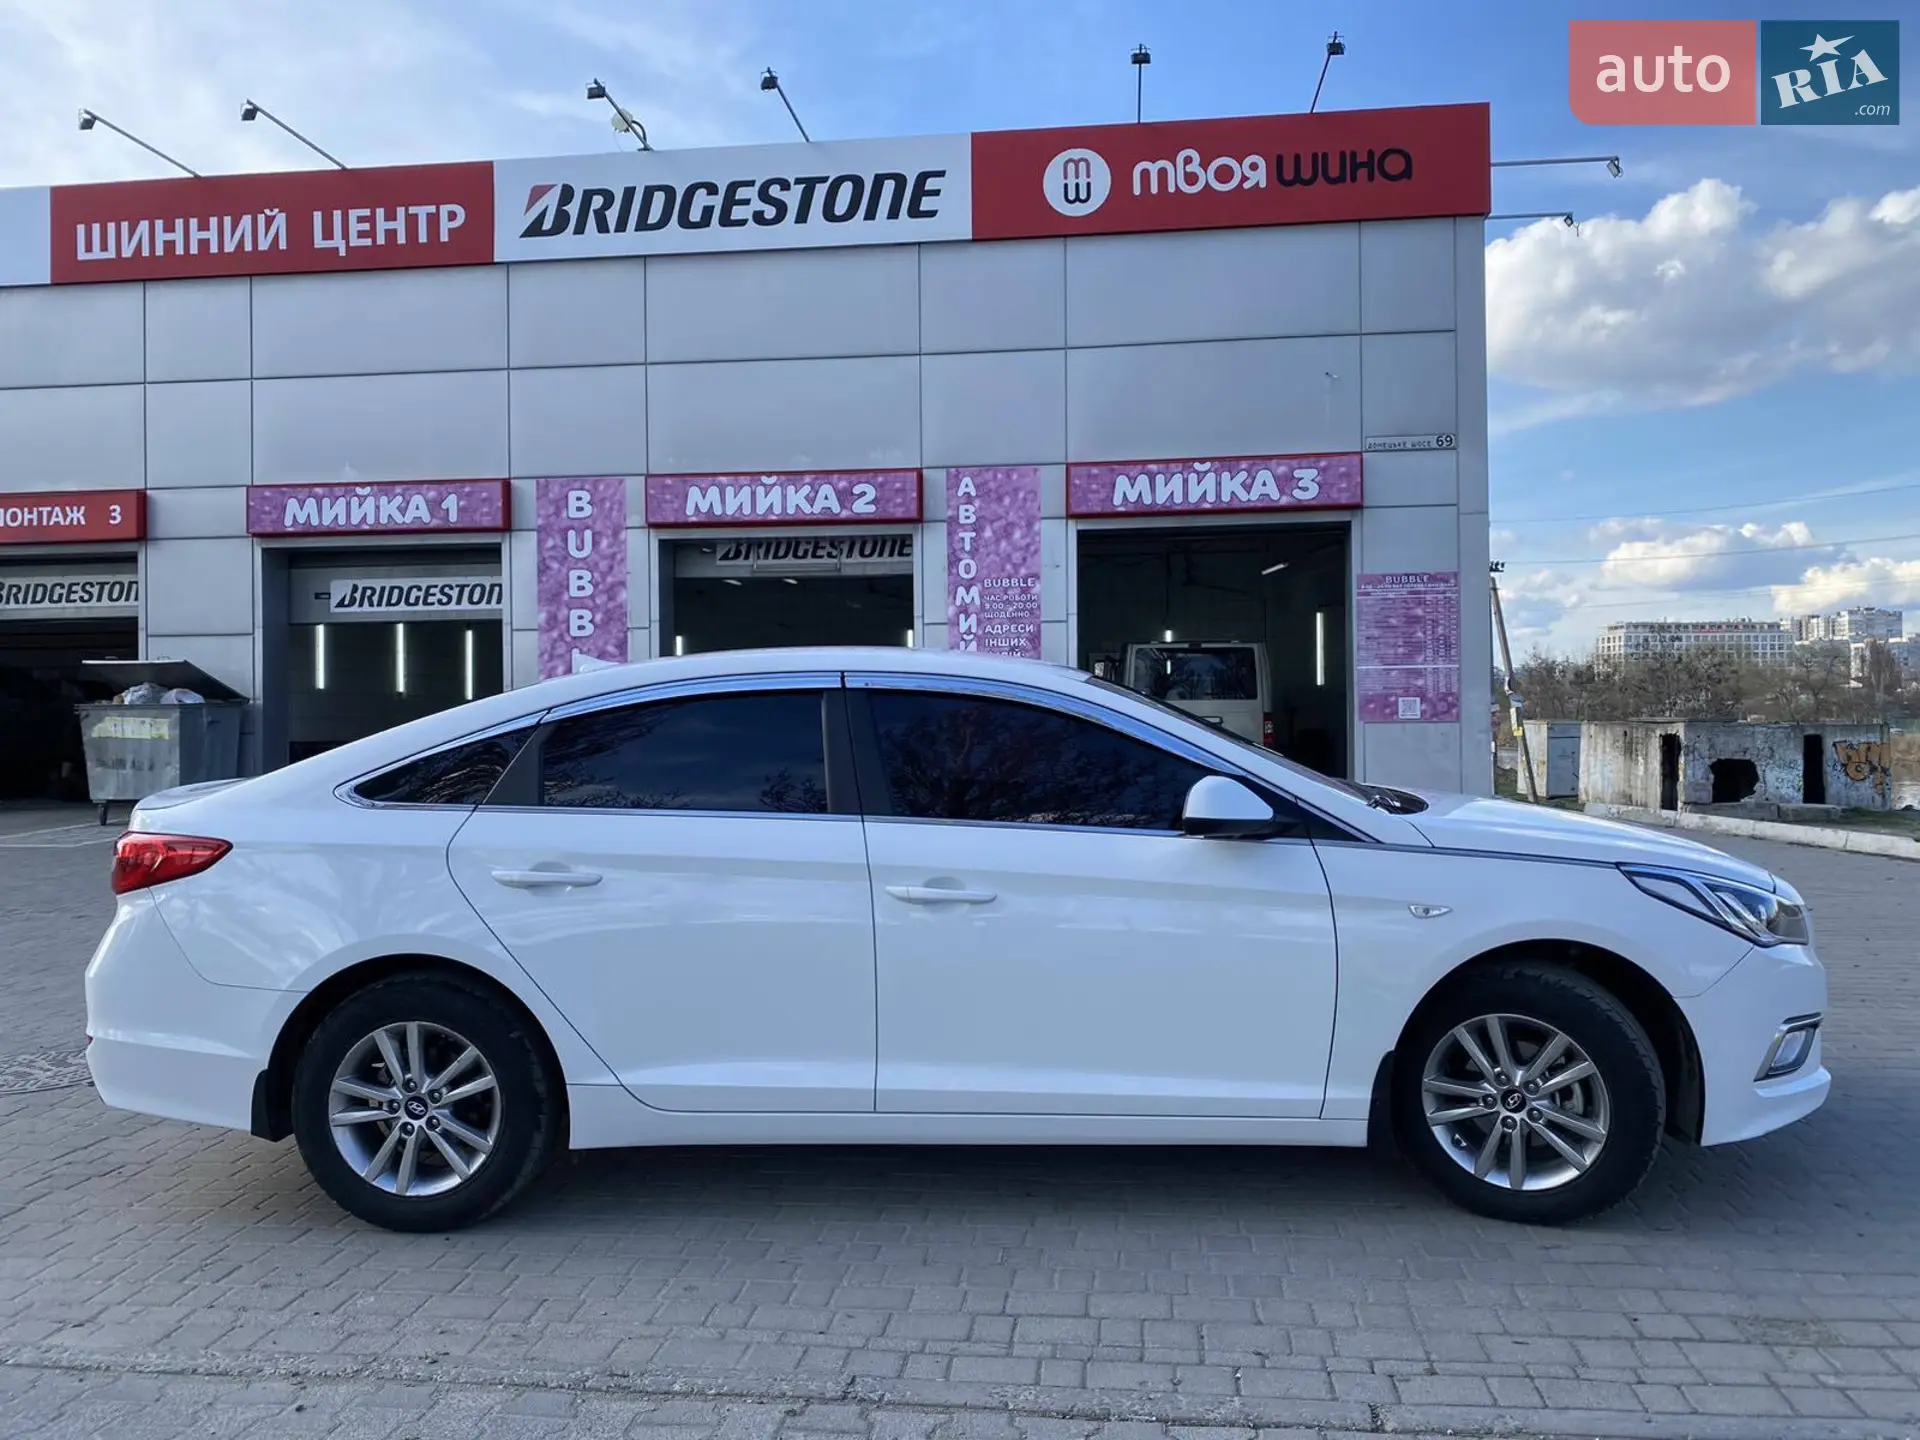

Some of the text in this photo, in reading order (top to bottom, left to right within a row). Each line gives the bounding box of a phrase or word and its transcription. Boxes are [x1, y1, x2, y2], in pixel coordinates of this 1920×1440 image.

[1276, 147, 1413, 187] шина
[519, 169, 947, 239] BRIDGESTONE
[76, 203, 467, 261] ШИННИЙ ЦЕНТР
[1436, 434, 1454, 448] 69
[685, 474, 878, 517] МИЙКА 2
[1112, 461, 1321, 507] МИЙКА 3
[0, 503, 122, 528] ОНТАЖ 3
[283, 486, 459, 528] МИЙКА 1
[718, 537, 912, 562] BRIDGESTONE
[983, 577, 1036, 588] BUBBLE
[1384, 574, 1430, 584] BUBBLE
[984, 623, 1035, 635] АДРЕСИ
[985, 637, 1027, 647] ІНШИХ
